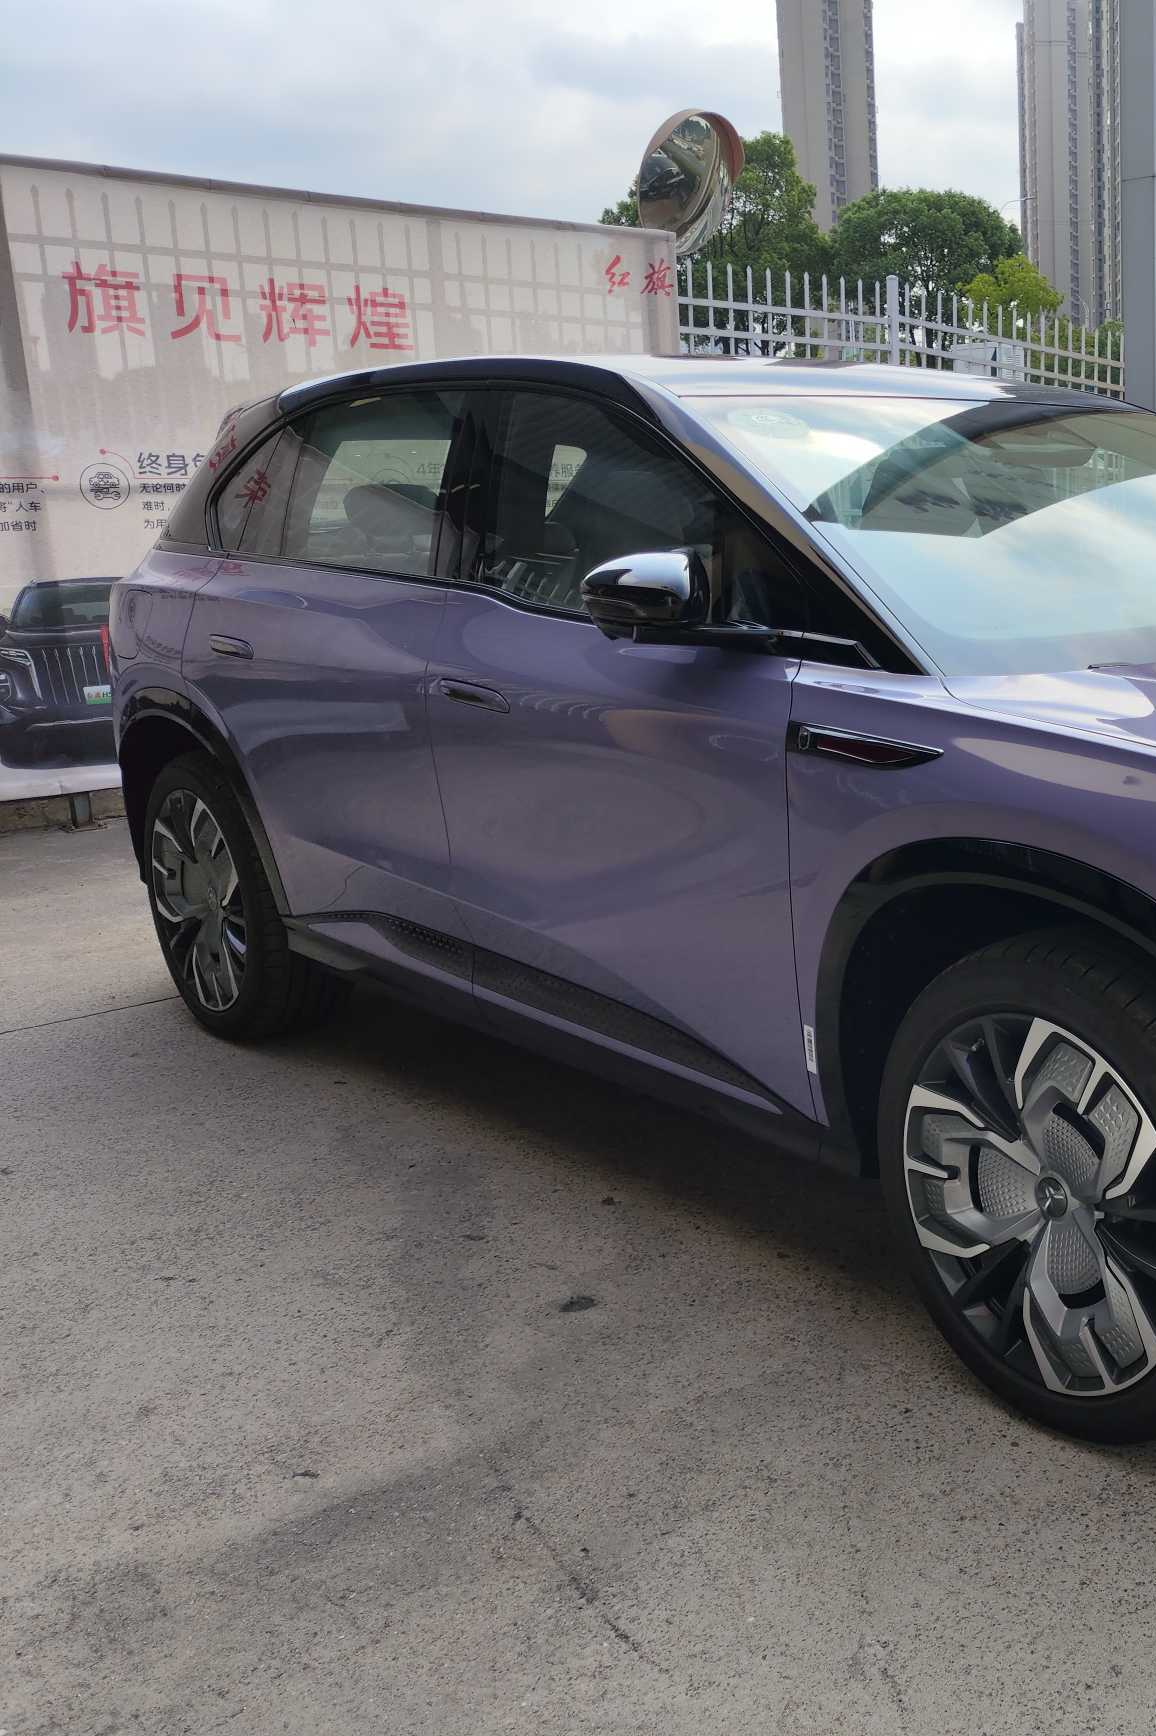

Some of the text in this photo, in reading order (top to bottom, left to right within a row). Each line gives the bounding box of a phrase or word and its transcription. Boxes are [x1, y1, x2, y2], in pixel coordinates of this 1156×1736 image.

[62, 261, 414, 350] 旗见辉煌
[605, 255, 674, 296] 红旗
